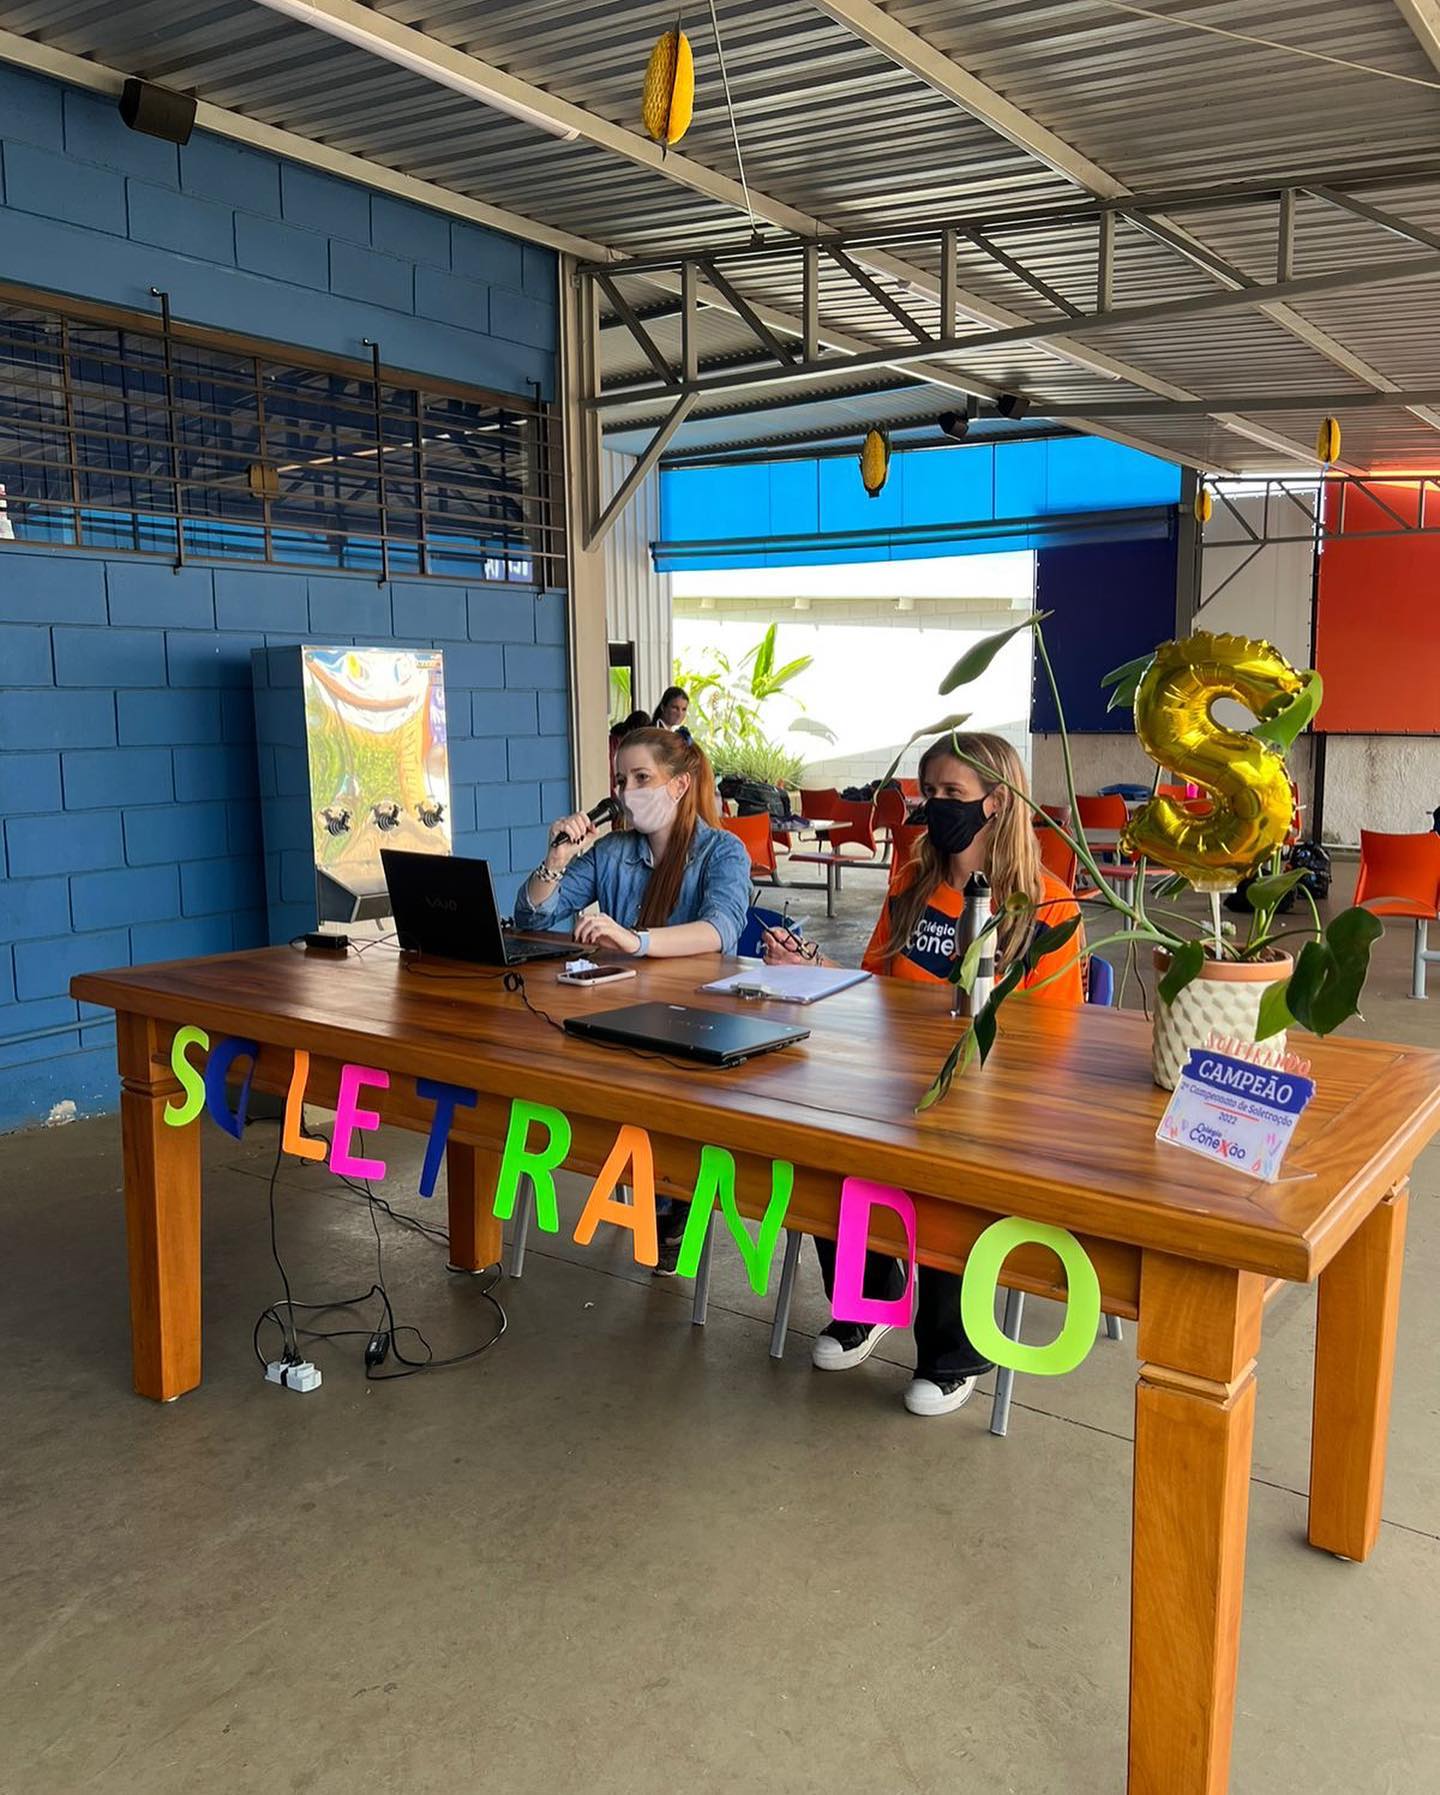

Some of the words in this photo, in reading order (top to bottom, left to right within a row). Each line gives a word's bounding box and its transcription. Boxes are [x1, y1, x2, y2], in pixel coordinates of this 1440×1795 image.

[1199, 1060, 1293, 1104] CAMPEÃO
[1218, 1111, 1238, 1125] 2022
[1237, 1100, 1248, 1111] de
[1247, 1104, 1293, 1128] Soletração
[164, 1024, 1101, 1376] SOLETRANDO
